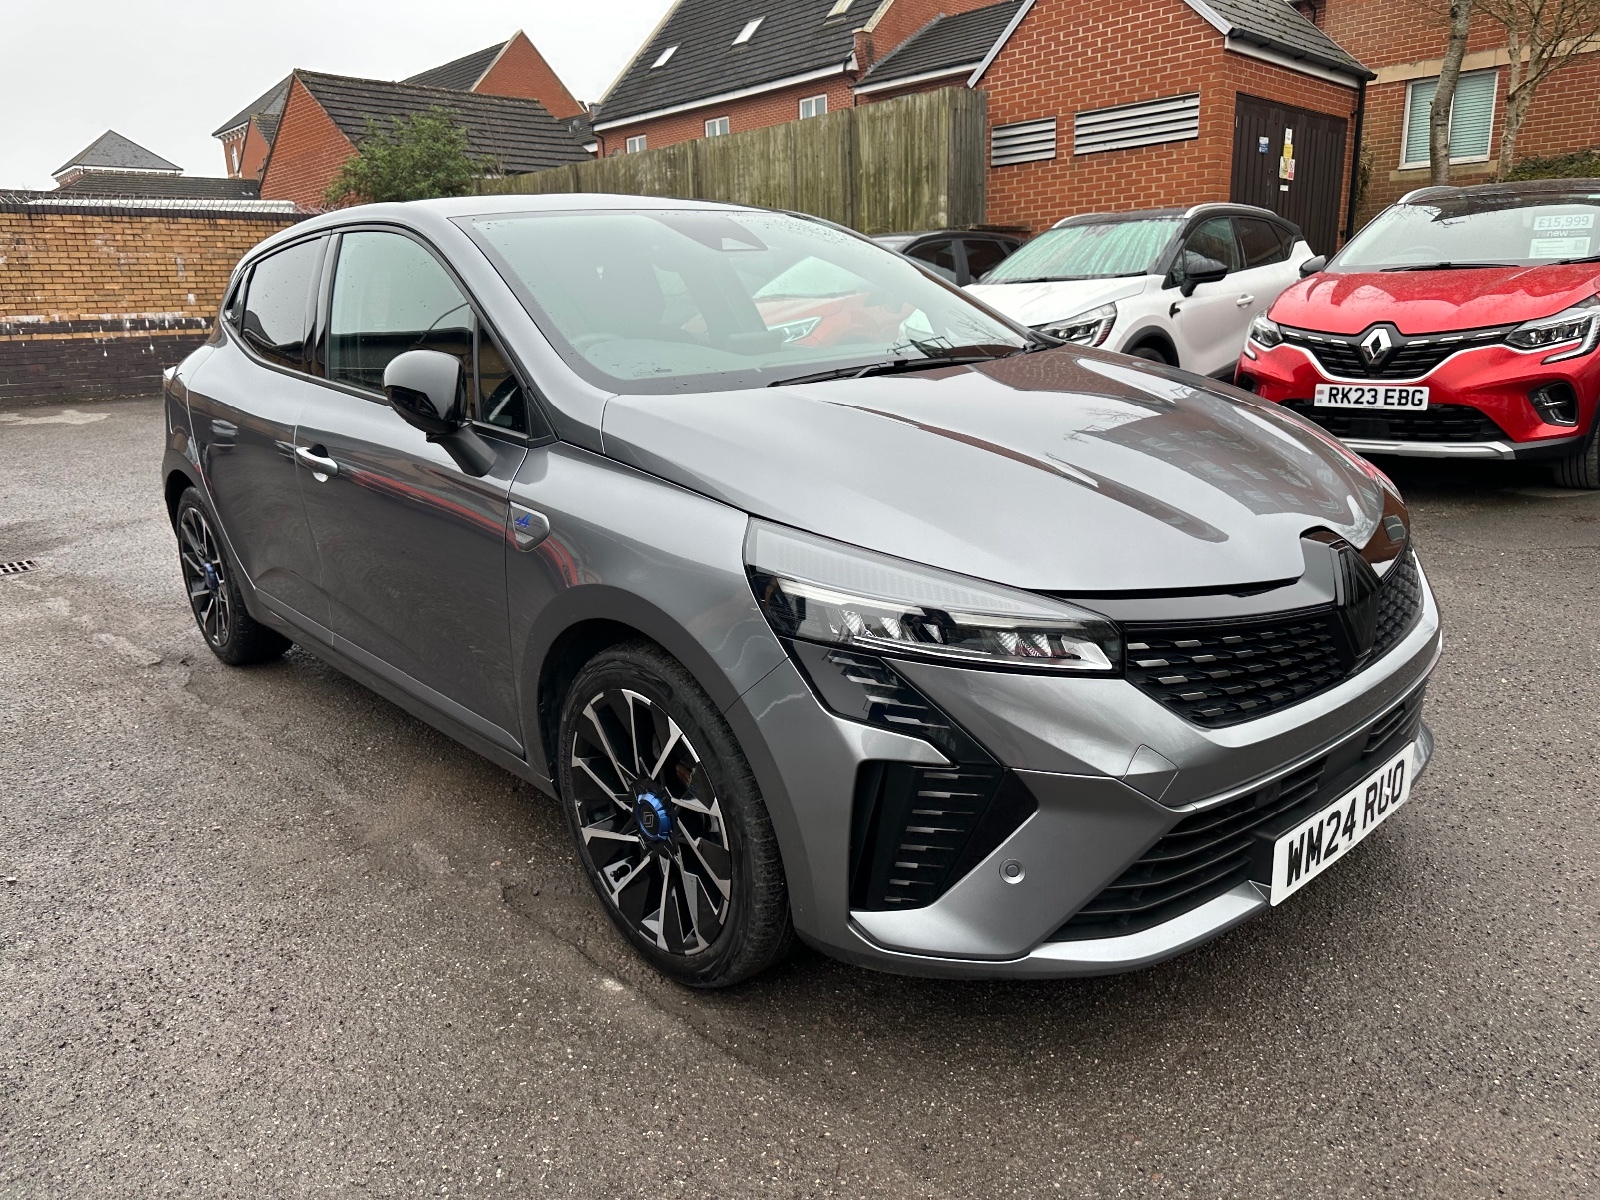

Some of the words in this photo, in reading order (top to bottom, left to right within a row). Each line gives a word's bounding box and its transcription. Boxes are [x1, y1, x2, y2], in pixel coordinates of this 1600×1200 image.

[1538, 215, 1590, 229] £15,999
[1328, 387, 1378, 405] RK23
[1383, 388, 1424, 407] EBG
[1286, 797, 1357, 888] WM24
[1362, 759, 1405, 830] RUO
